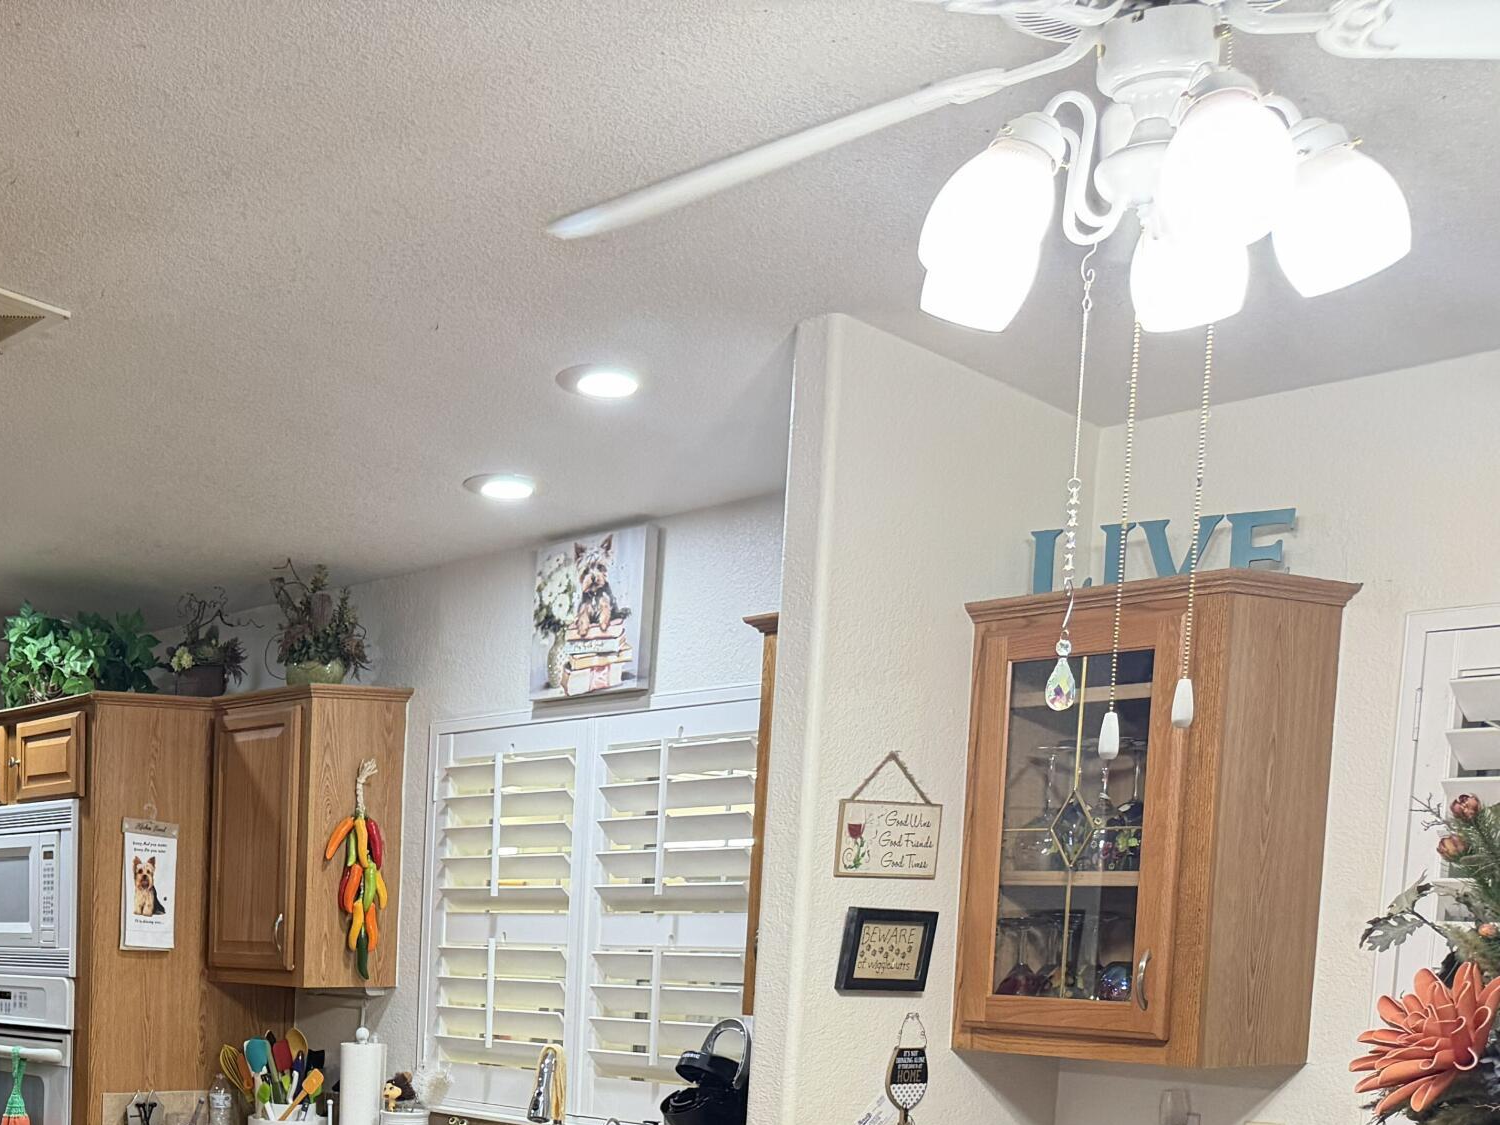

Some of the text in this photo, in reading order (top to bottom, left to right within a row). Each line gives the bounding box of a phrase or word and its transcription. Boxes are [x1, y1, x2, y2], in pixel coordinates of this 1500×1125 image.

[1031, 507, 1297, 595] LIVE
[884, 810, 909, 827] Good
[878, 830, 933, 848] Good Friends
[880, 851, 905, 868] Good
[861, 925, 917, 945] BEWARE
[897, 1069, 922, 1083] HOME
